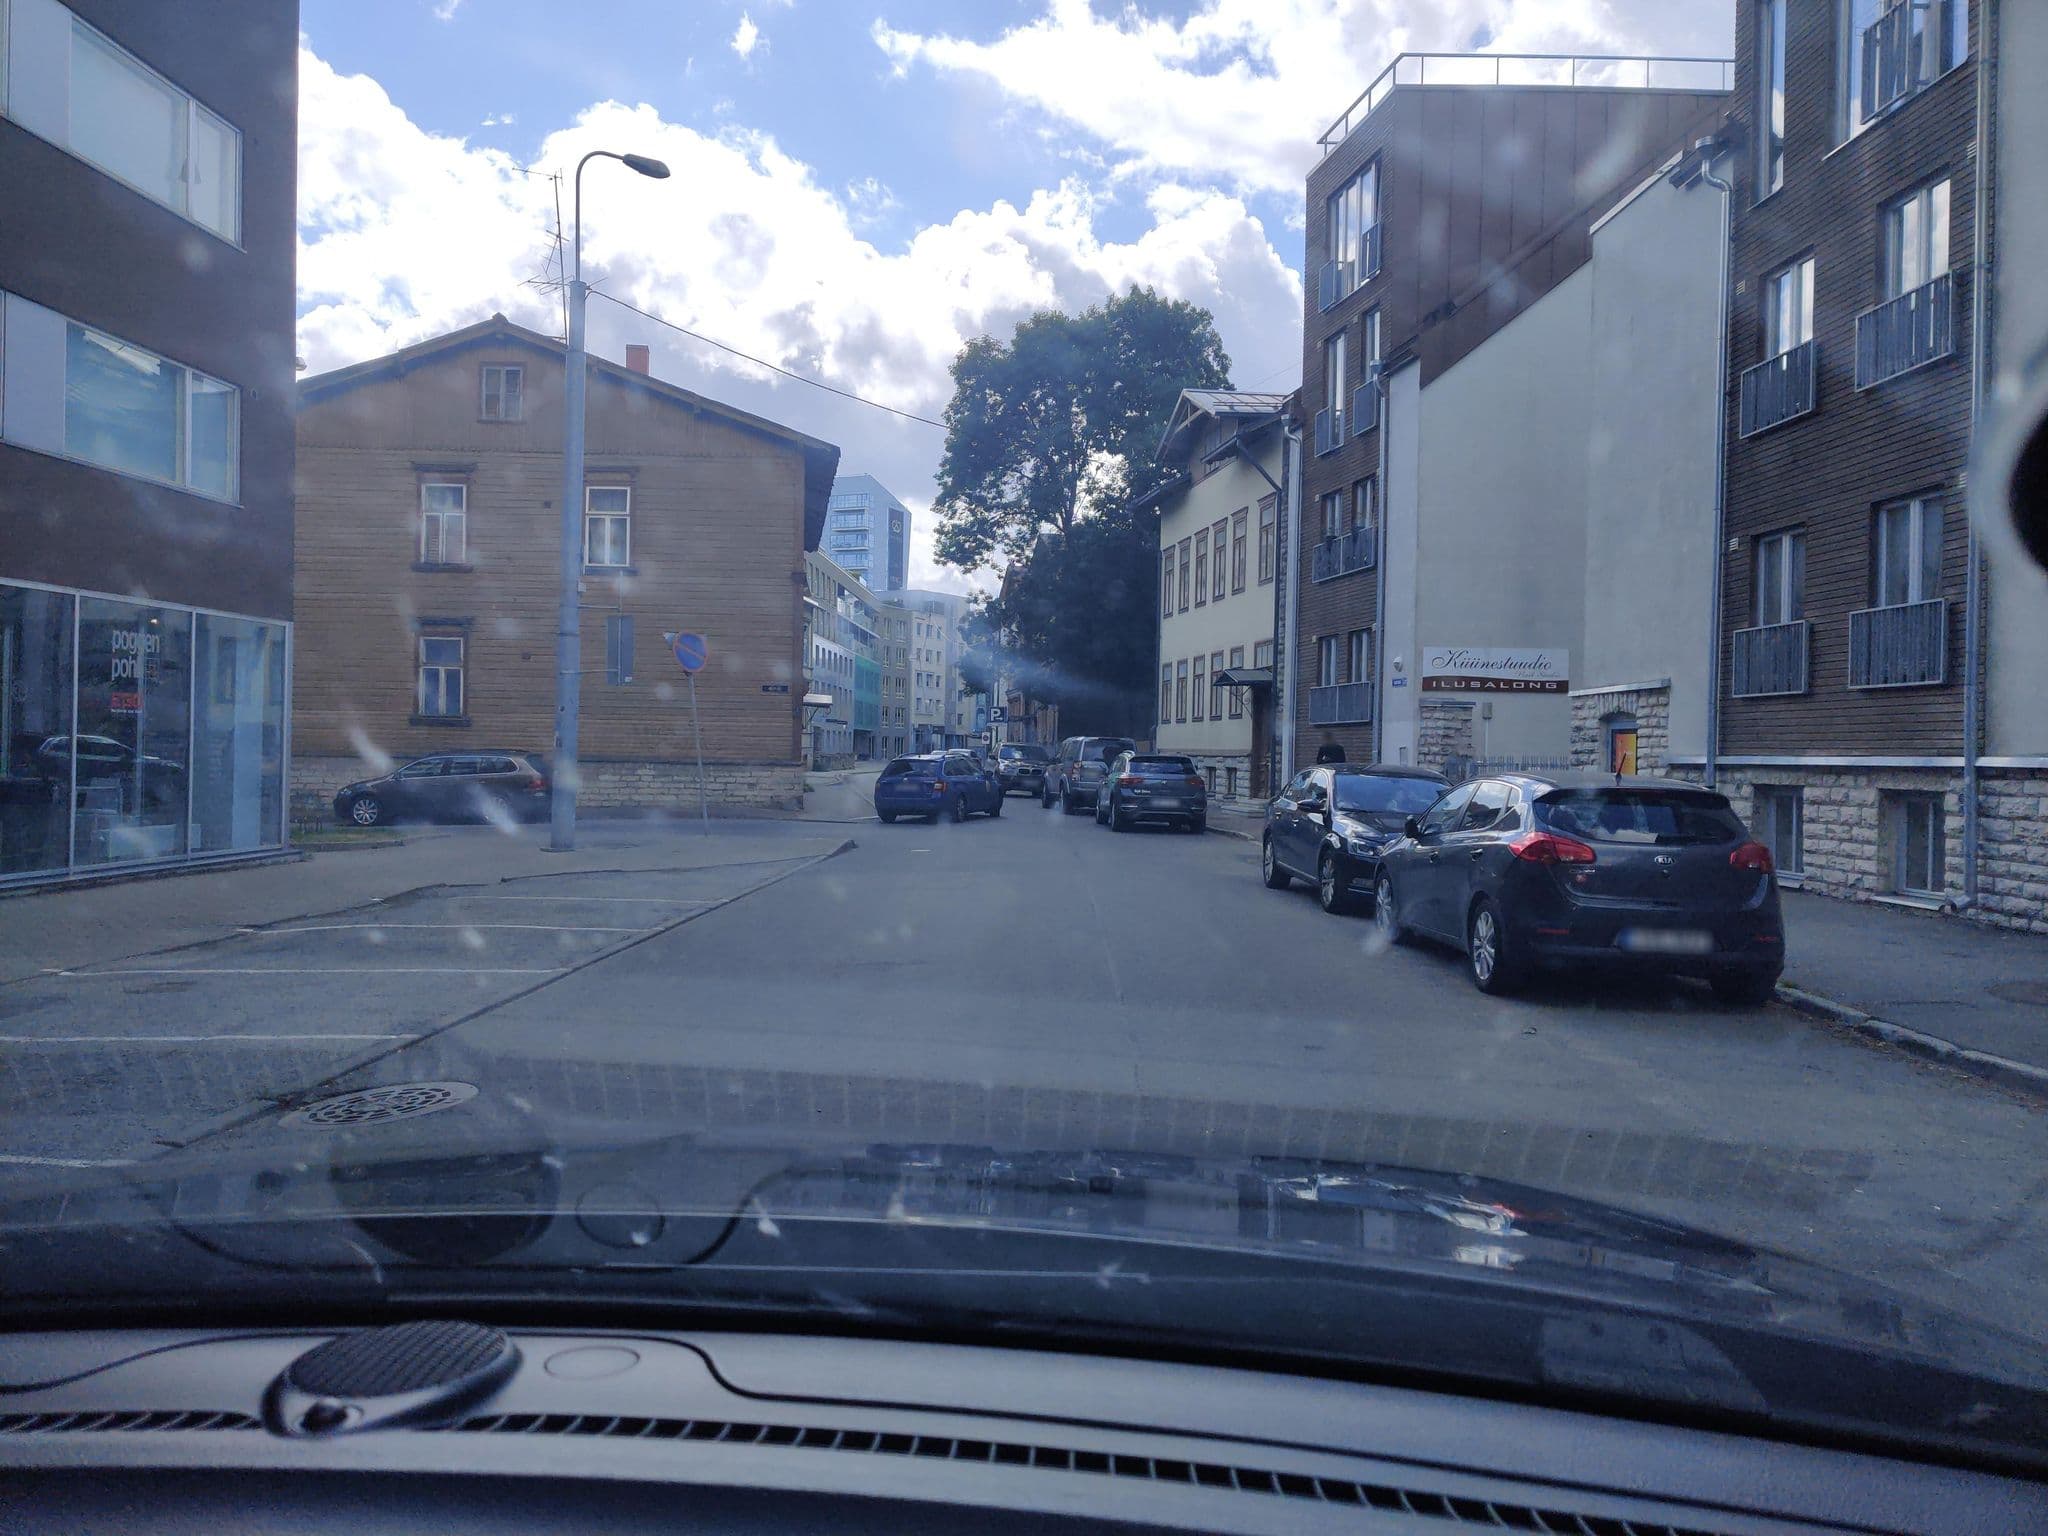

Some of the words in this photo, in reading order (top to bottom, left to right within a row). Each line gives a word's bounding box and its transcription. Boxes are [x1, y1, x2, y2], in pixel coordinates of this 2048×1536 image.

[1431, 649, 1552, 671] Küünestuudio
[1432, 680, 1558, 690] ILUSALONG
[991, 708, 1002, 721] P
